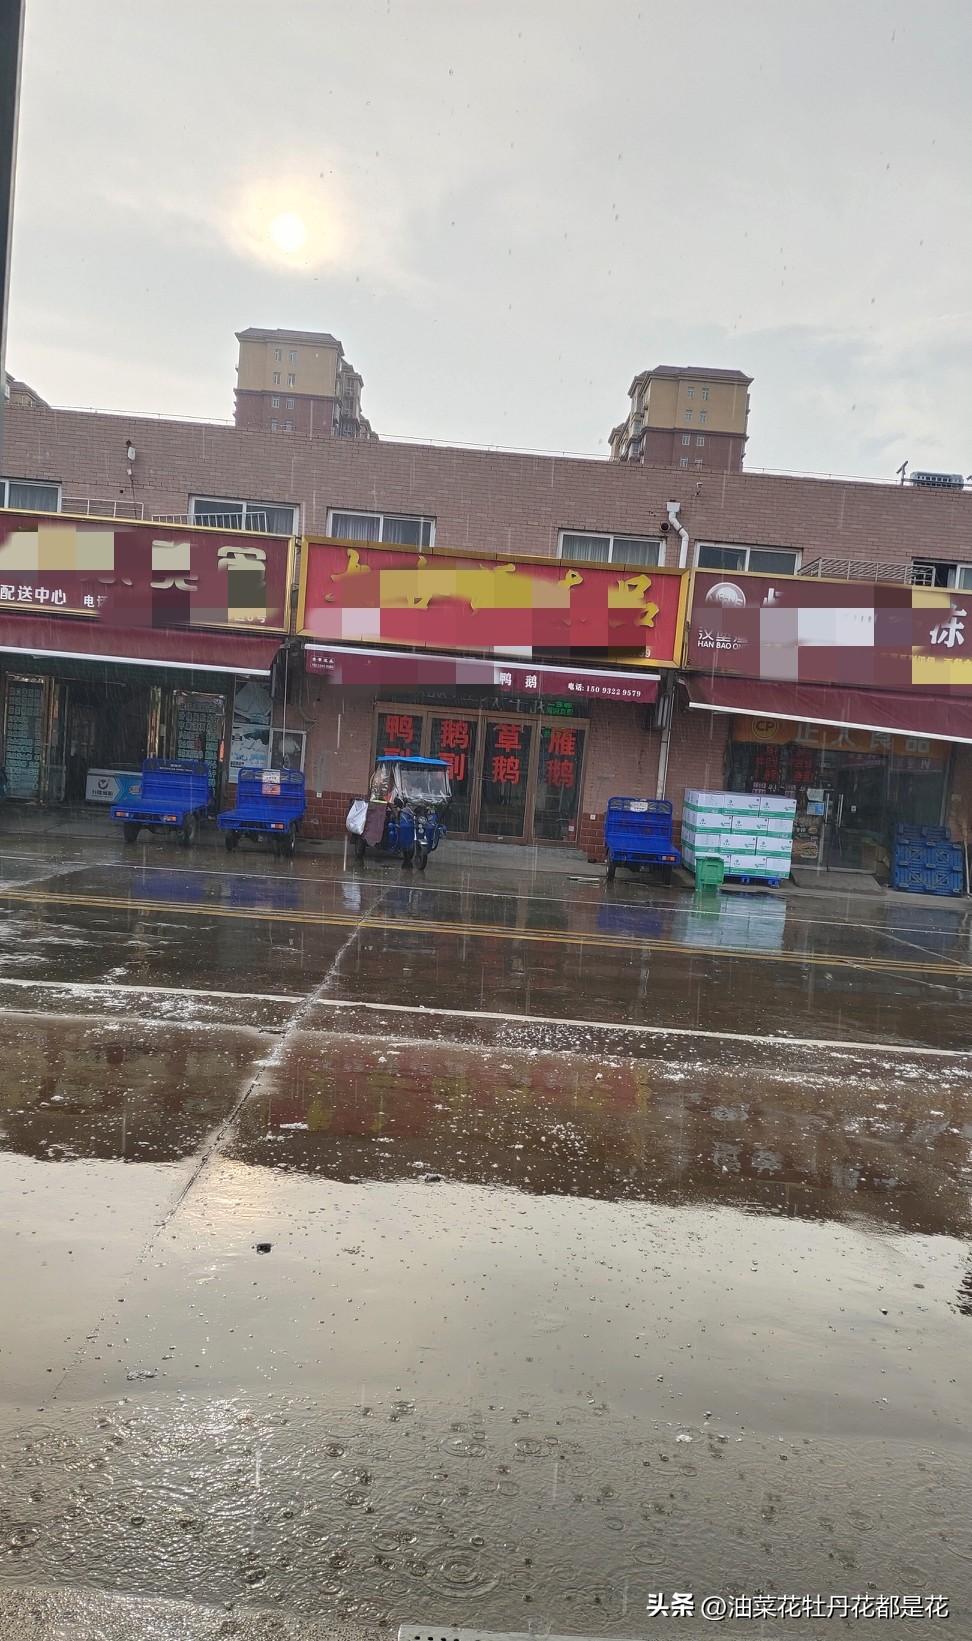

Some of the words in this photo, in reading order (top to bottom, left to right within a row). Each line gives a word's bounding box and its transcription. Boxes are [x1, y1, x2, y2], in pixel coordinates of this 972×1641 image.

[0, 584, 67, 605] 配送中心
[697, 640, 715, 649] HAN
[716, 642, 732, 650] BAO
[602, 687, 621, 696] 9322
[622, 689, 641, 698] 9579
[755, 719, 775, 732] CP
